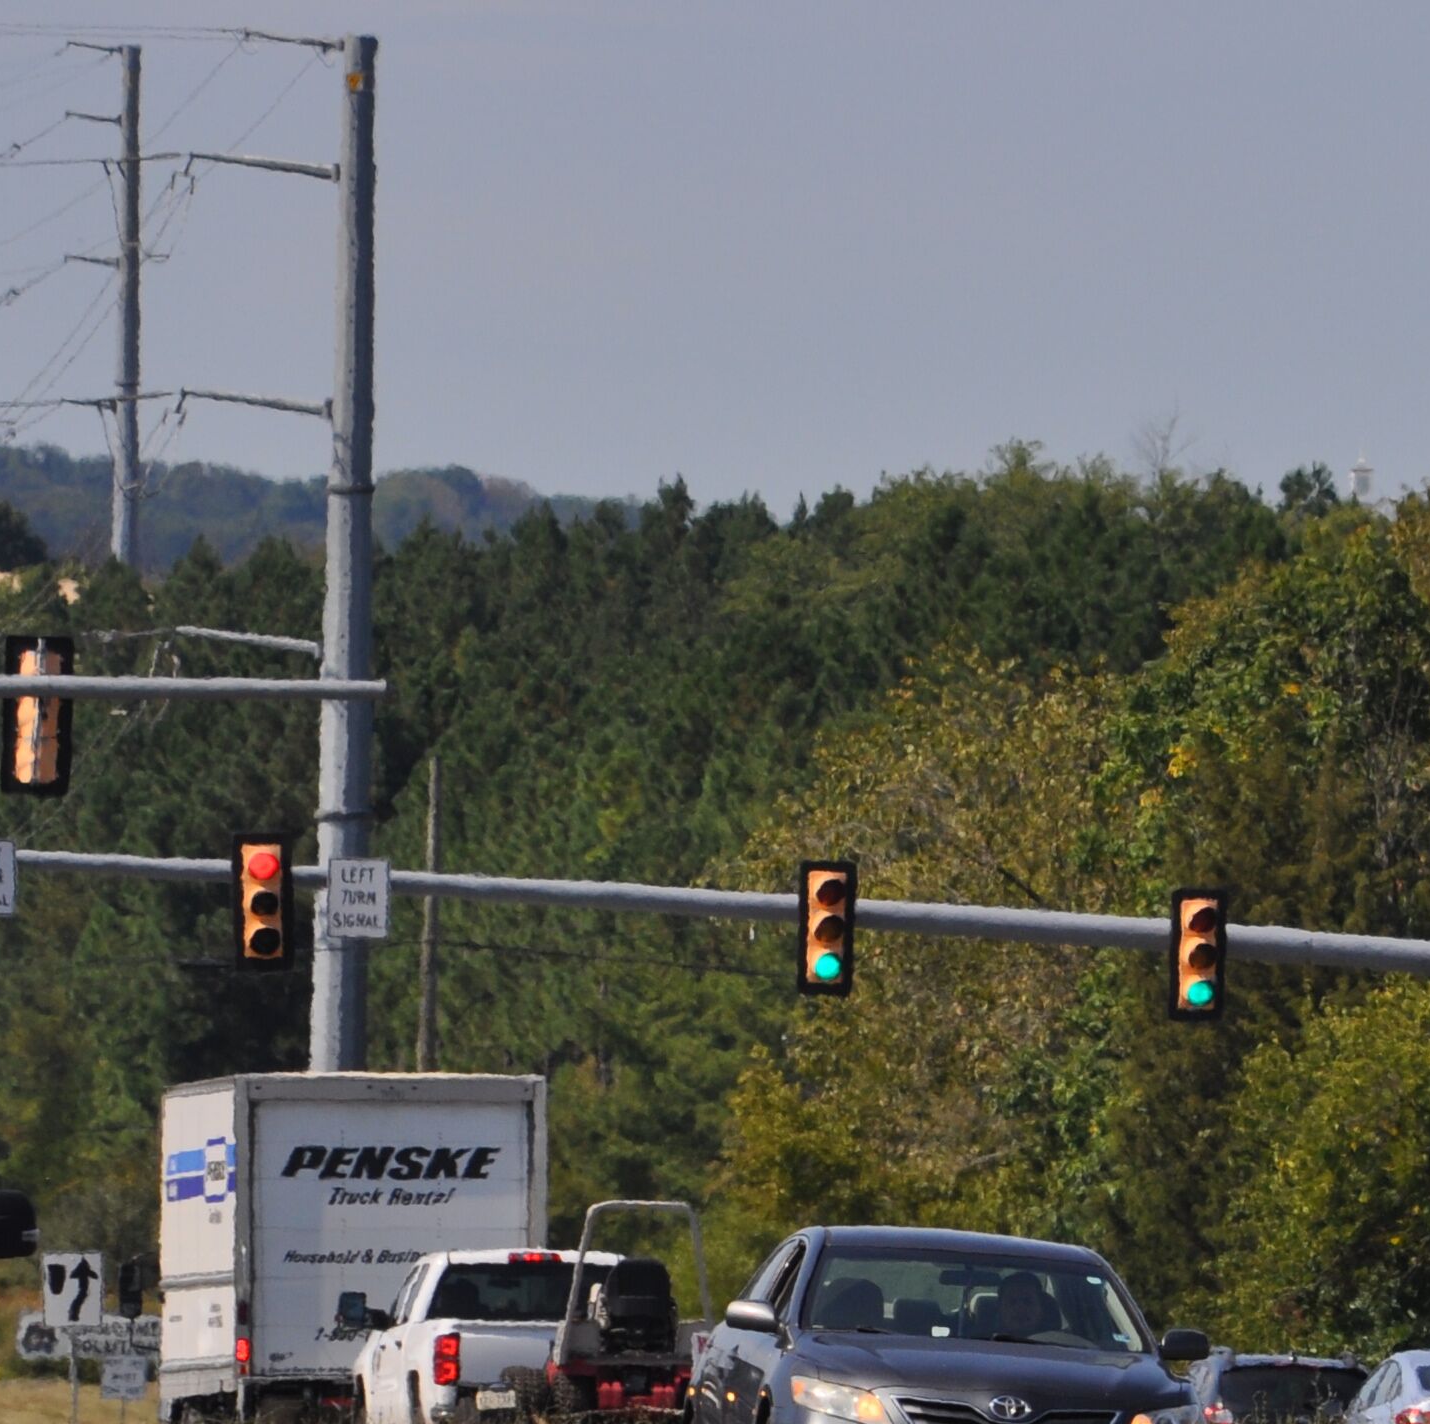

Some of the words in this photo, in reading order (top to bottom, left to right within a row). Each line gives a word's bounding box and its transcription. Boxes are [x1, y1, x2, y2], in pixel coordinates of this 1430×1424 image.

[341, 867, 375, 884] LEFT
[341, 889, 377, 906] TURN
[332, 911, 383, 929] SIGNAL
[280, 1145, 501, 1181] PENSKE
[327, 1186, 383, 1206] Truck
[386, 1187, 456, 1206] Rental
[282, 1250, 360, 1265] Household
[360, 1249, 374, 1265] &
